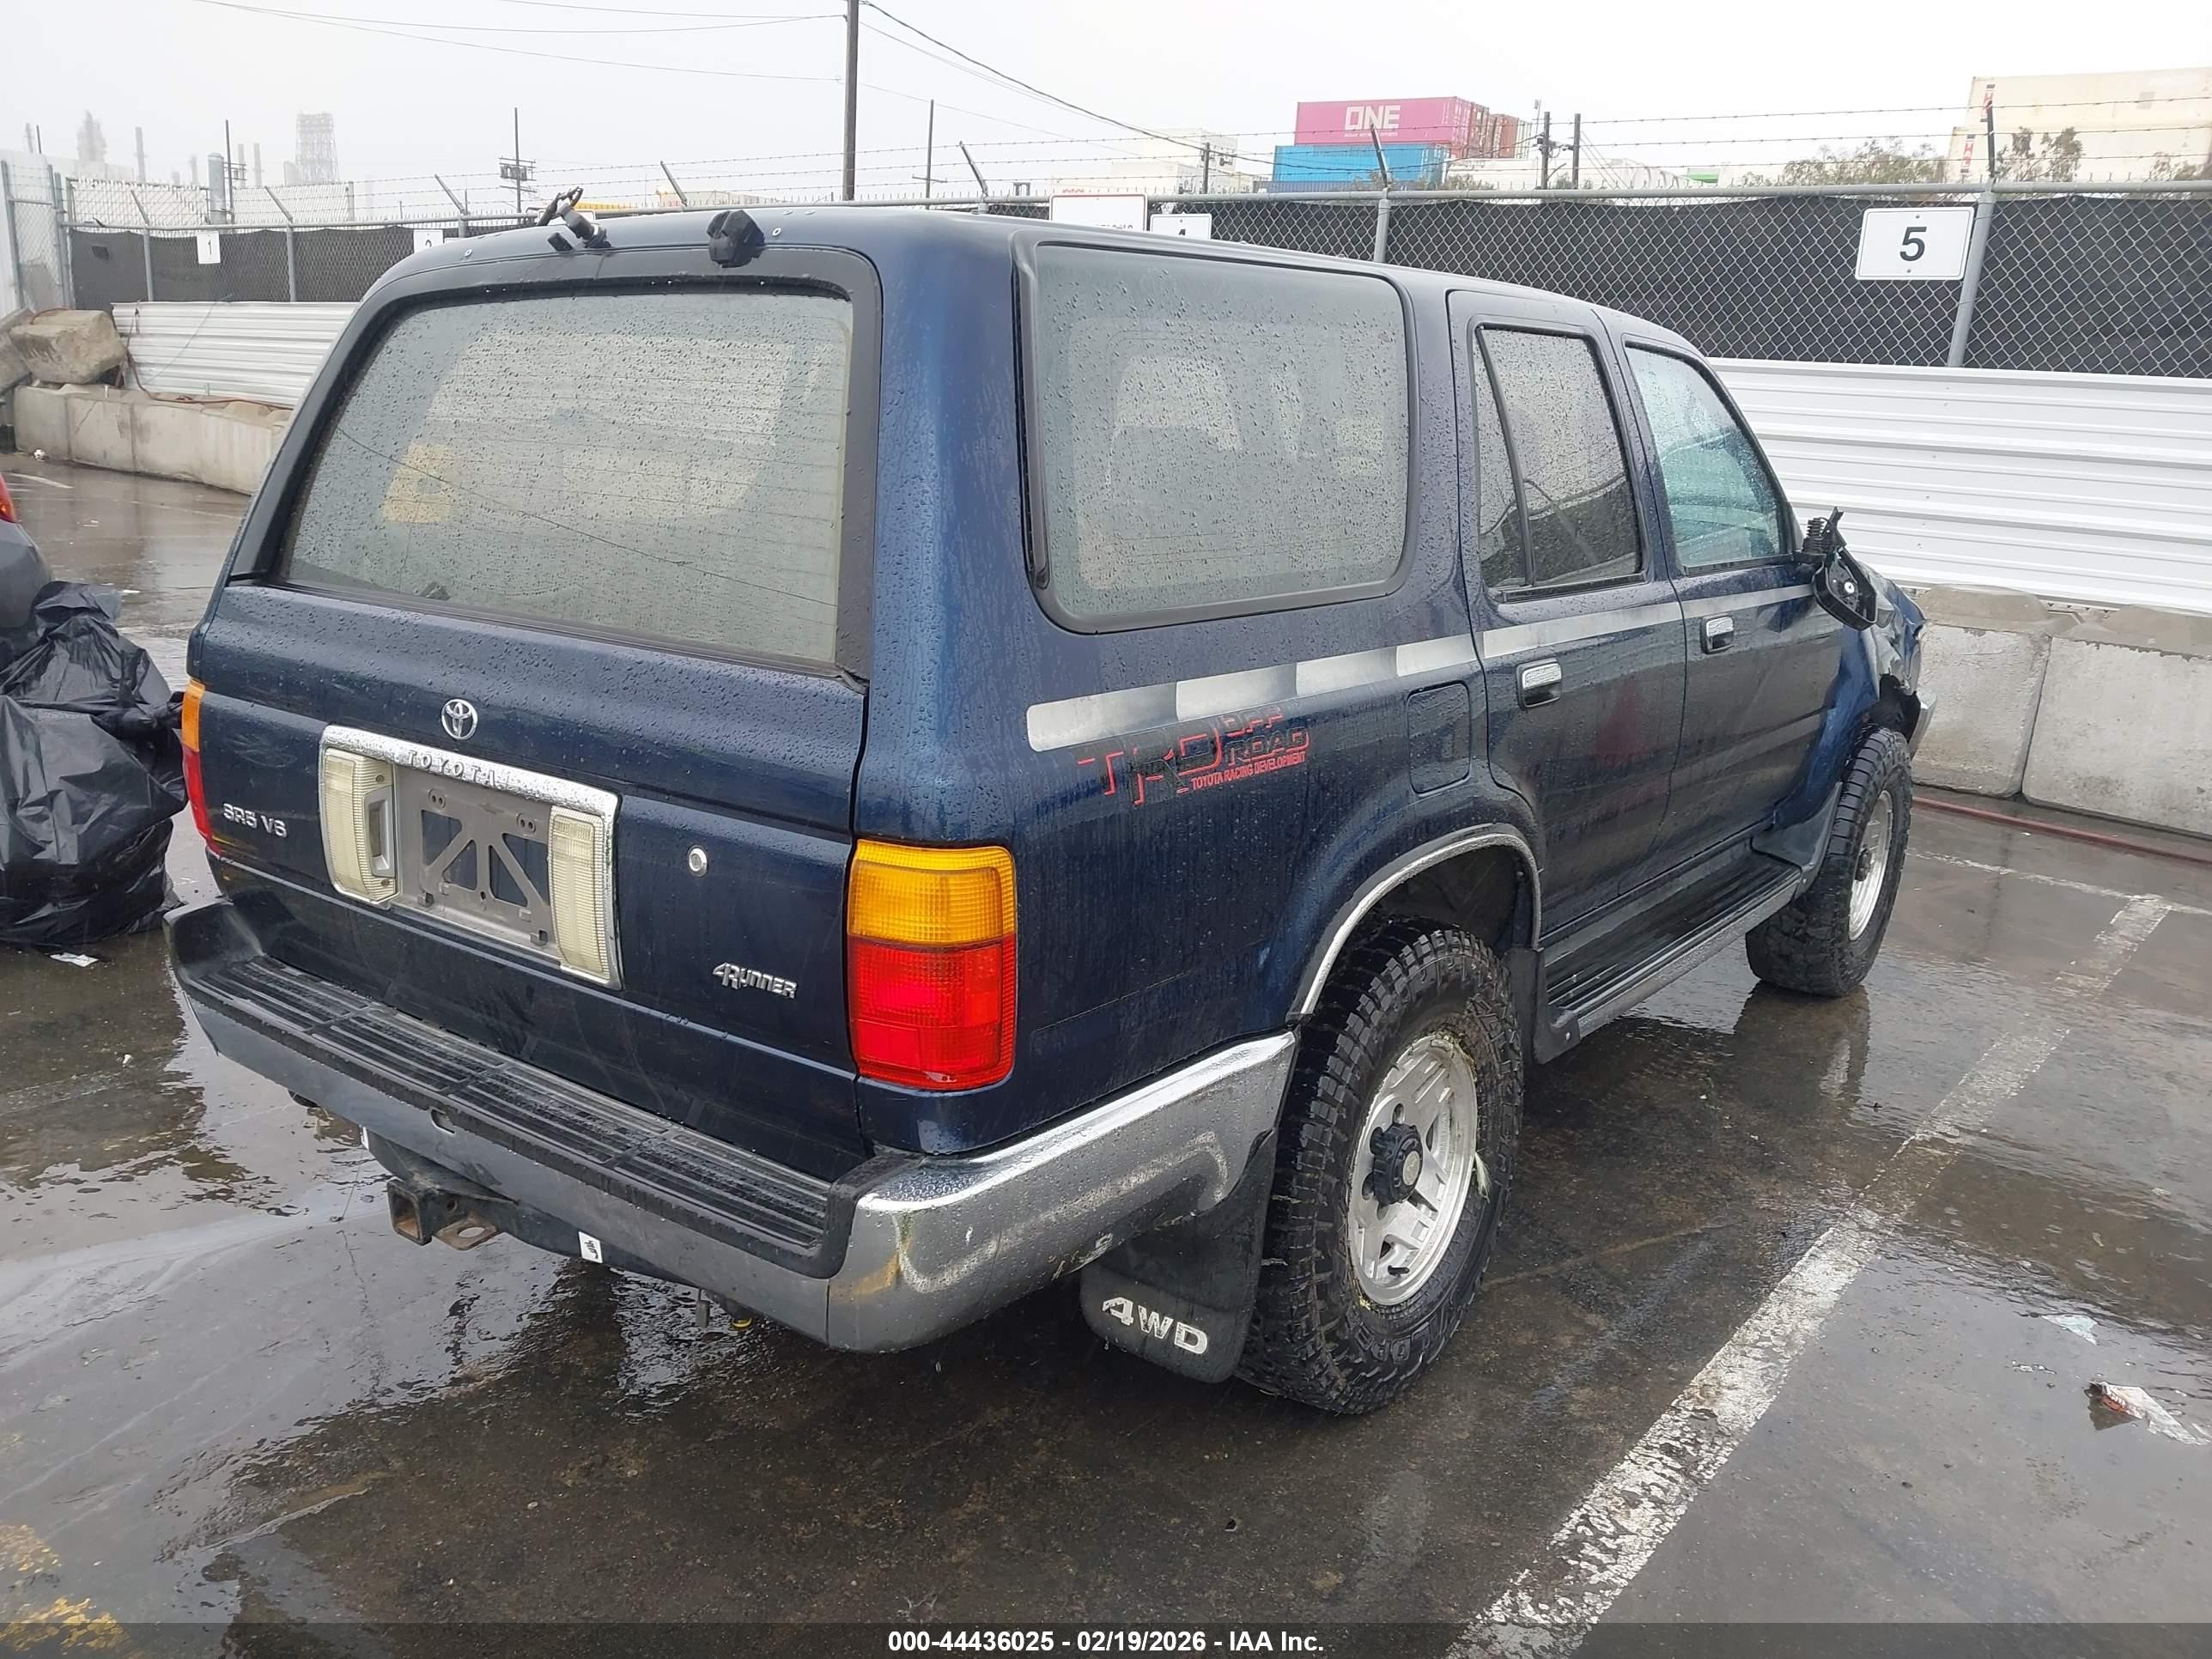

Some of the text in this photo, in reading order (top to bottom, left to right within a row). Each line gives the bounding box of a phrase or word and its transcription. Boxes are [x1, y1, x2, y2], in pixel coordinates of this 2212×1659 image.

[1344, 105, 1401, 131] ONE
[1899, 226, 1928, 262] 5
[1078, 722, 1223, 806] TRD
[1224, 726, 1310, 767] ROAD
[409, 750, 496, 787] TOYOTA
[1191, 750, 1307, 791] TOYOTA RACING DEVELOPMENT
[223, 803, 287, 838] SR5 V6
[1103, 1297, 1208, 1354] 4WD
